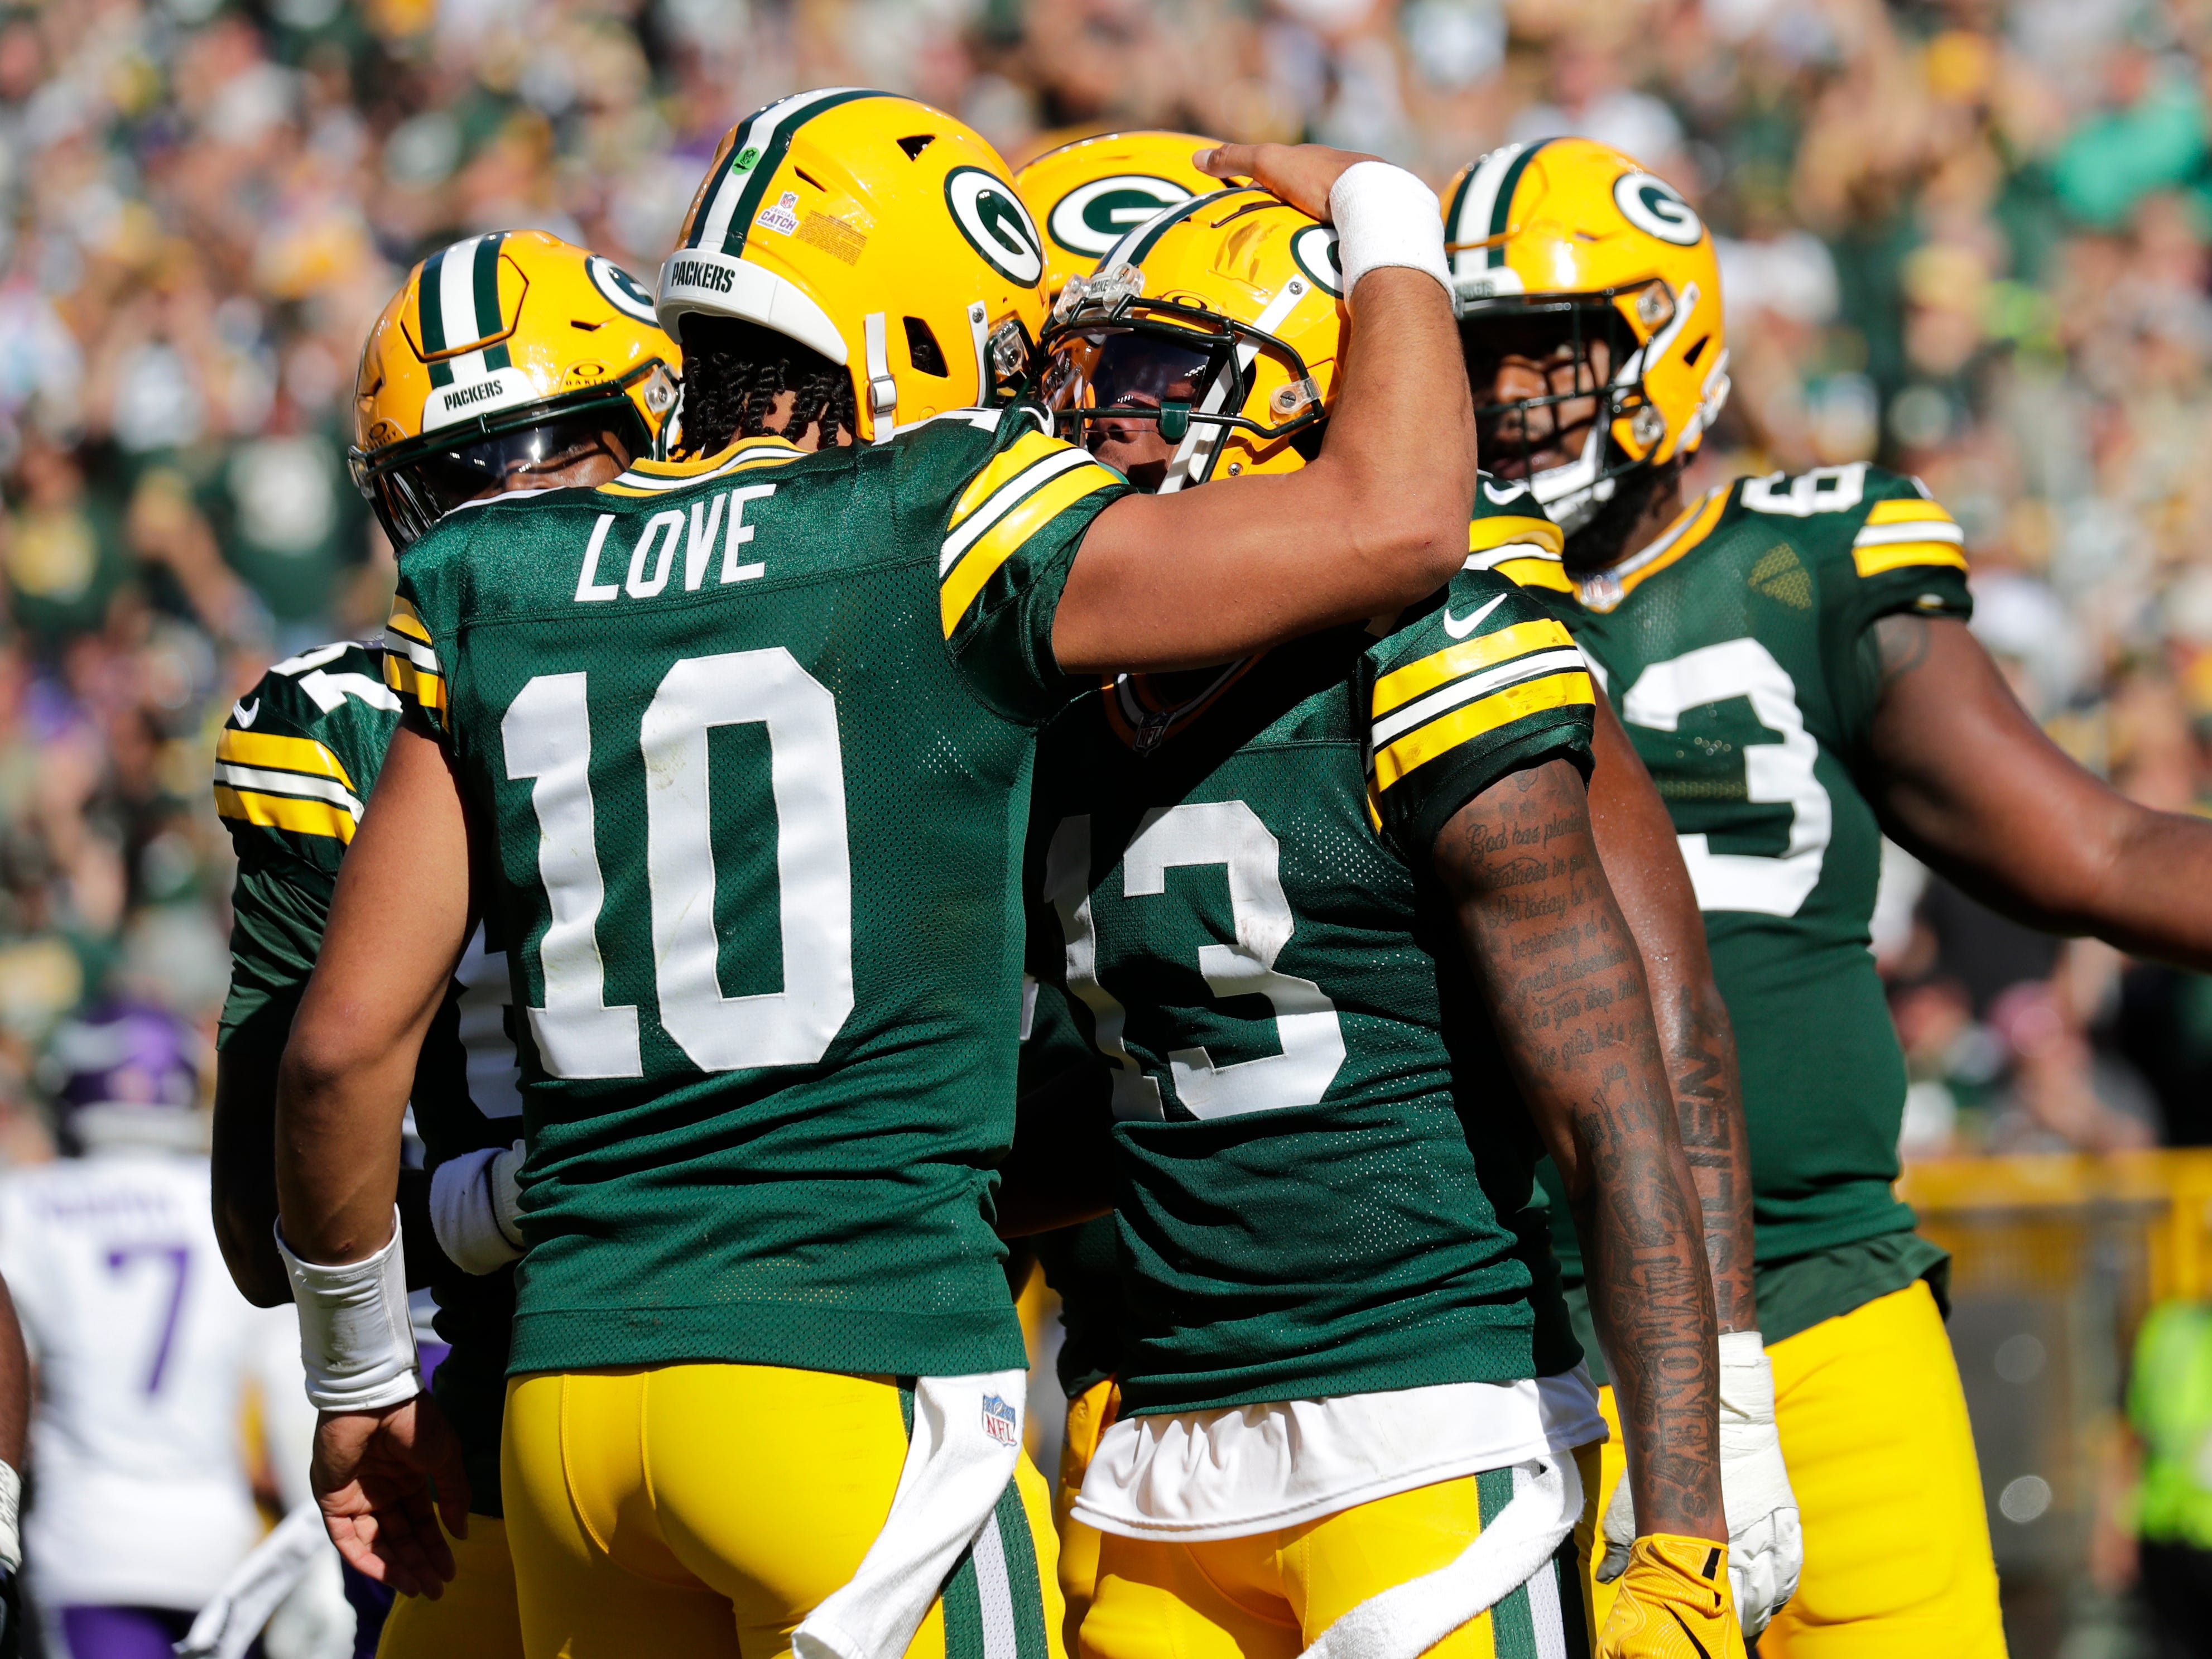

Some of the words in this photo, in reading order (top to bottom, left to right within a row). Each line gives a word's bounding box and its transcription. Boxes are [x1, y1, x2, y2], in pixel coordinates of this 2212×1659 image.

[761, 211, 797, 230] CATCH
[770, 207, 794, 219] CRUCIAL
[671, 261, 735, 293] PACKERS
[444, 380, 503, 411] PACKERS
[574, 483, 777, 602] LOVE
[1465, 823, 1507, 865] God
[1512, 821, 1540, 844] has
[501, 646, 855, 1079] 10
[1044, 800, 1347, 1121] 13
[107, 1246, 190, 1395] 7
[985, 1413, 1015, 1442] NFL
